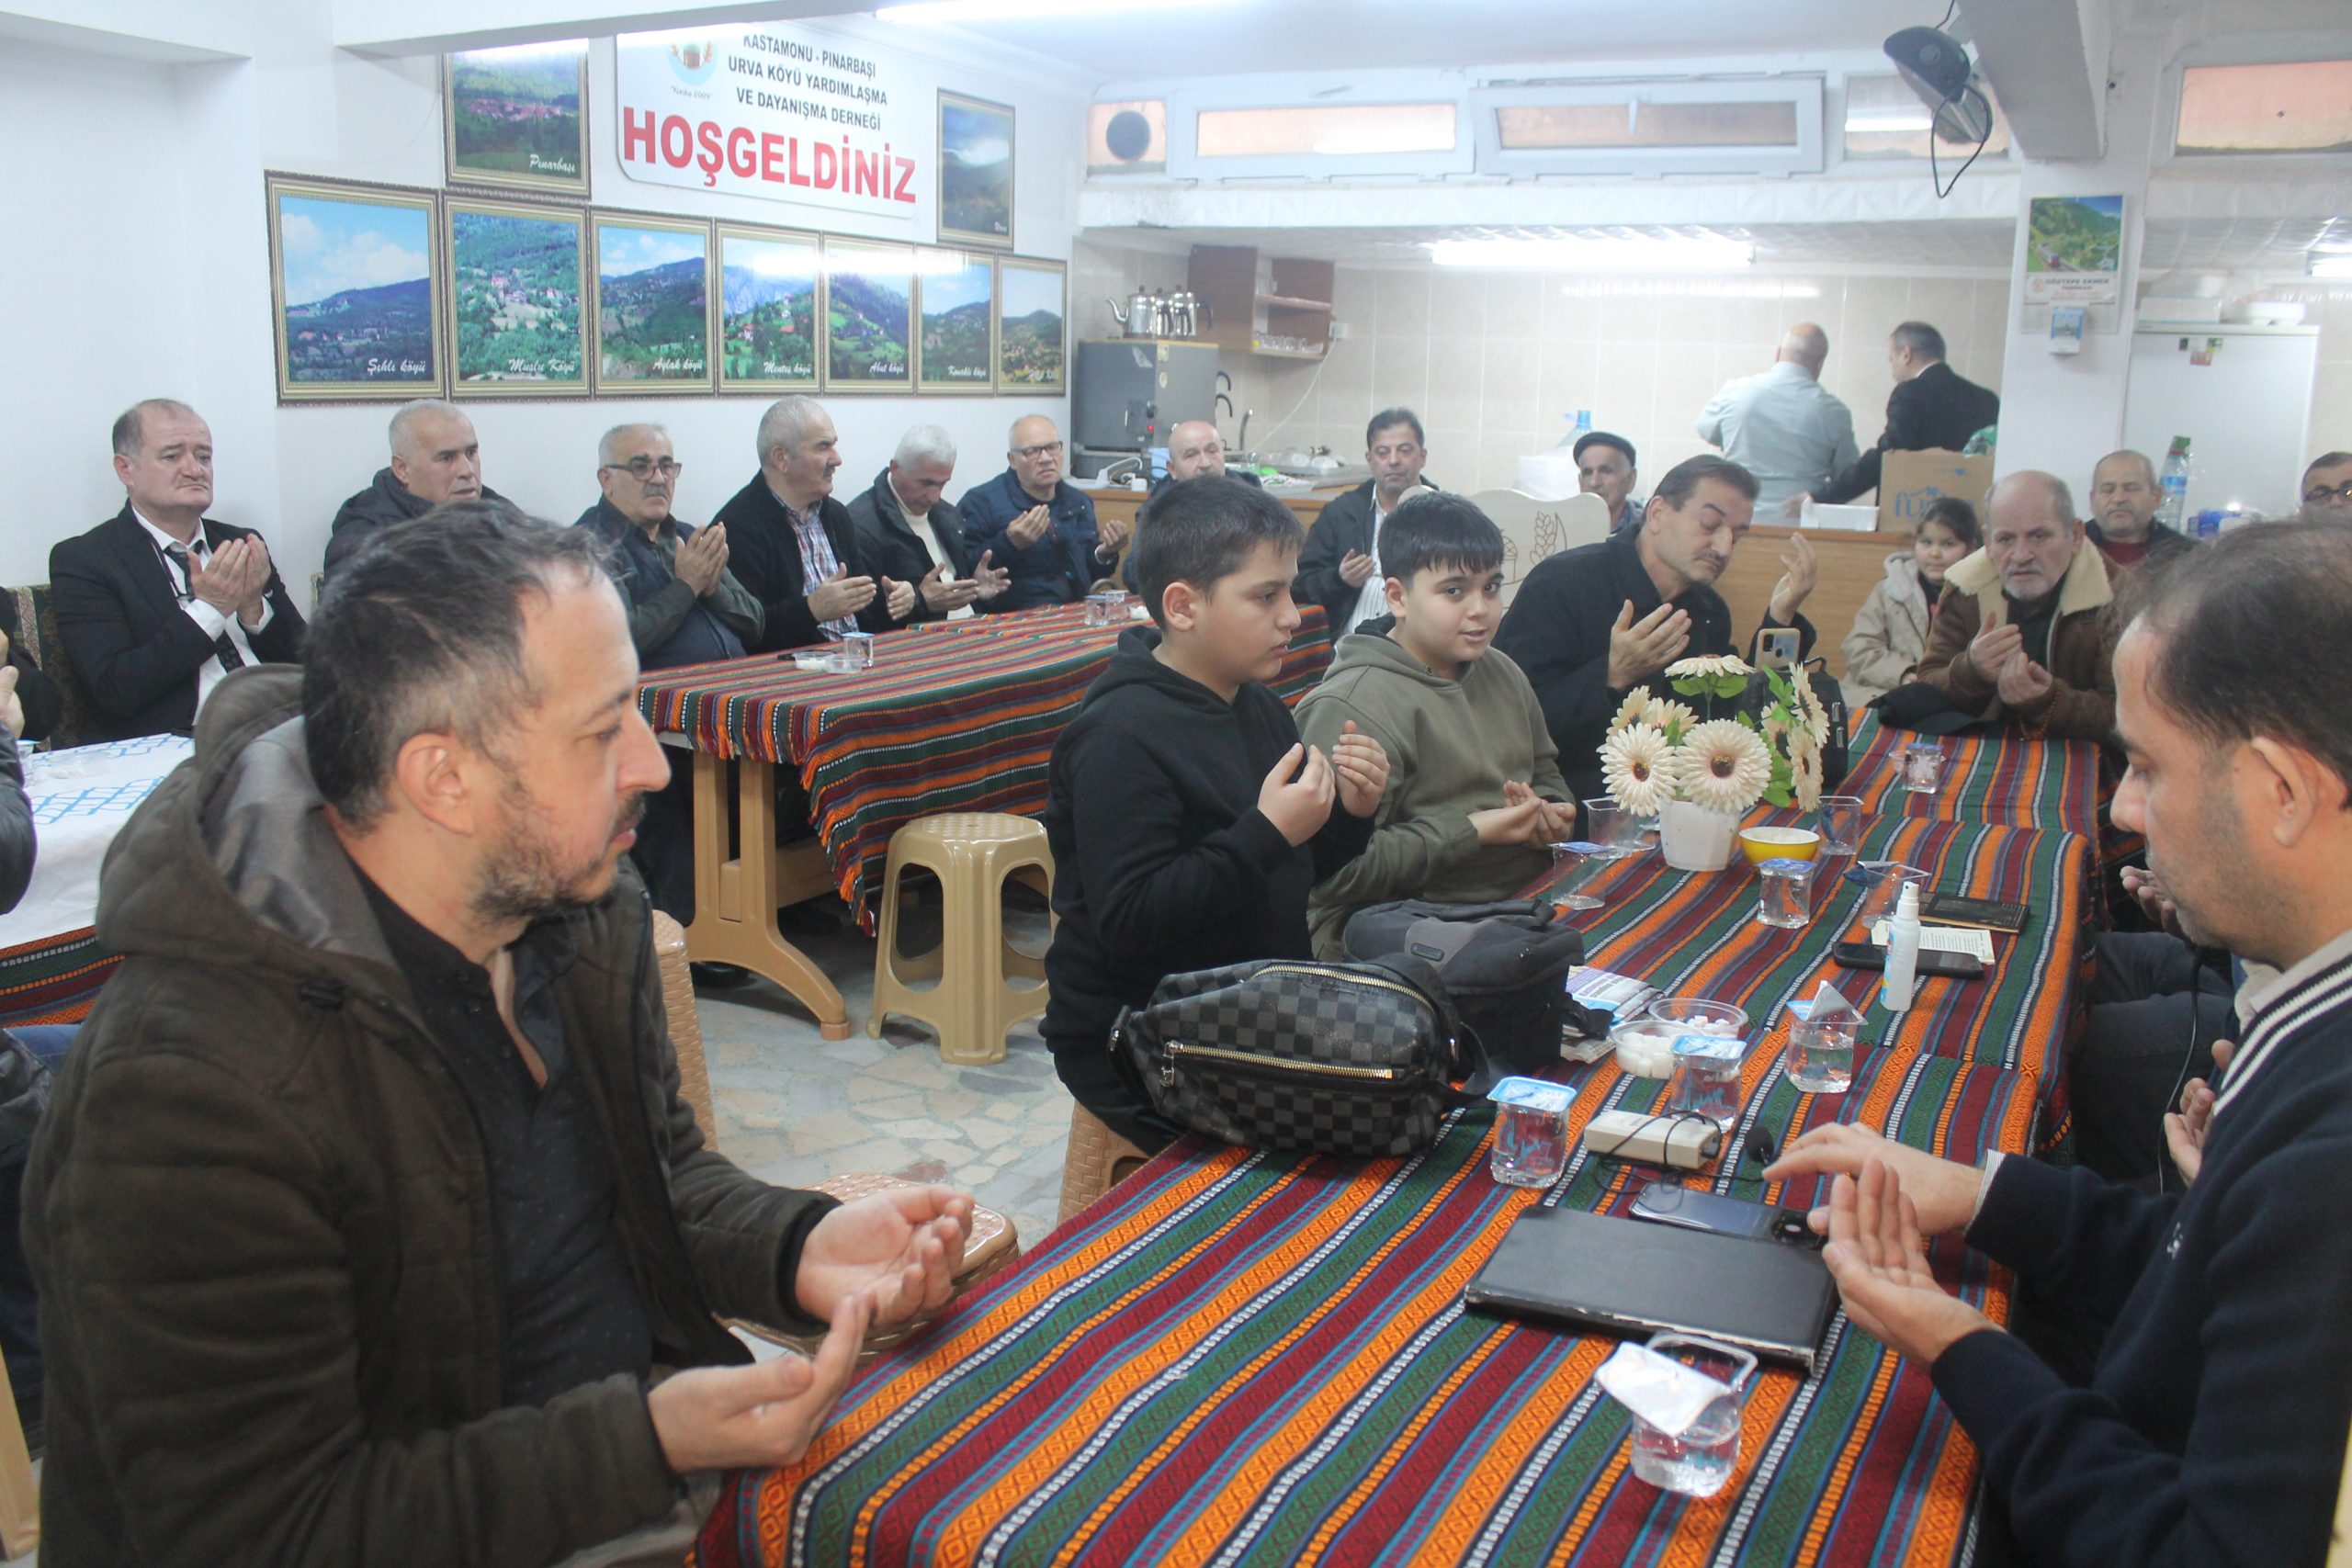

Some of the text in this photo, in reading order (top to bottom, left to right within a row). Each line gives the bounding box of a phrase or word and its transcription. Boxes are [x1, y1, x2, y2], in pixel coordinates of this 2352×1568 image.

[743, 34, 813, 62] KASTAMONU
[821, 49, 876, 81] PINARBAŞI
[728, 55, 888, 106] URVA KÖYÜ YARDIMLAŞMA
[736, 86, 881, 131] VE DAYANIŞMA DERNEĞİ
[529, 153, 575, 174] Pınarbaşı
[623, 106, 917, 204] HOŞGELDİNİZ
[400, 358, 426, 376] köyü
[548, 357, 575, 375] Köyü
[683, 358, 703, 373] köyü
[794, 362, 811, 376] köyü
